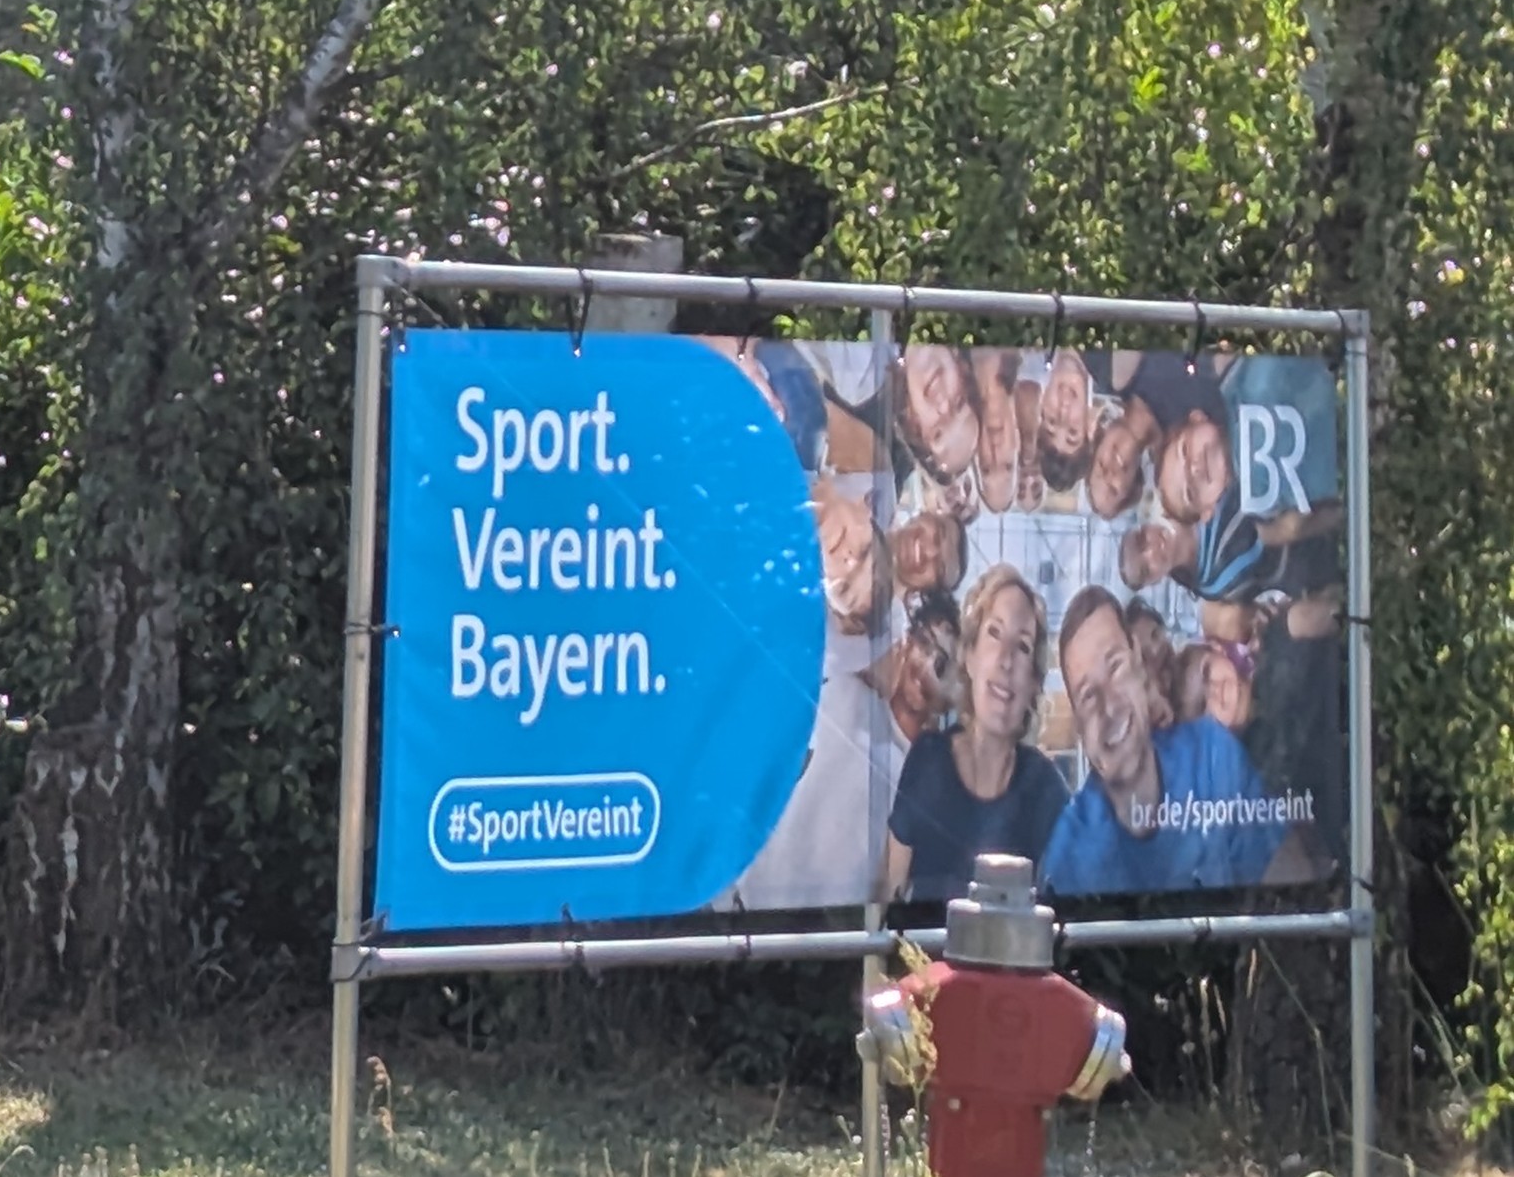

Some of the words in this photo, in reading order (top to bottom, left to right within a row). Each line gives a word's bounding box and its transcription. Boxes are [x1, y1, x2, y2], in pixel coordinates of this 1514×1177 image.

[455, 385, 631, 500] Sport.
[1238, 403, 1312, 515] BR
[451, 502, 677, 592] Vereint.
[450, 612, 667, 726] Bayern.
[448, 794, 644, 855] #SportVereint
[1130, 787, 1315, 839] br.de/sportvereint
